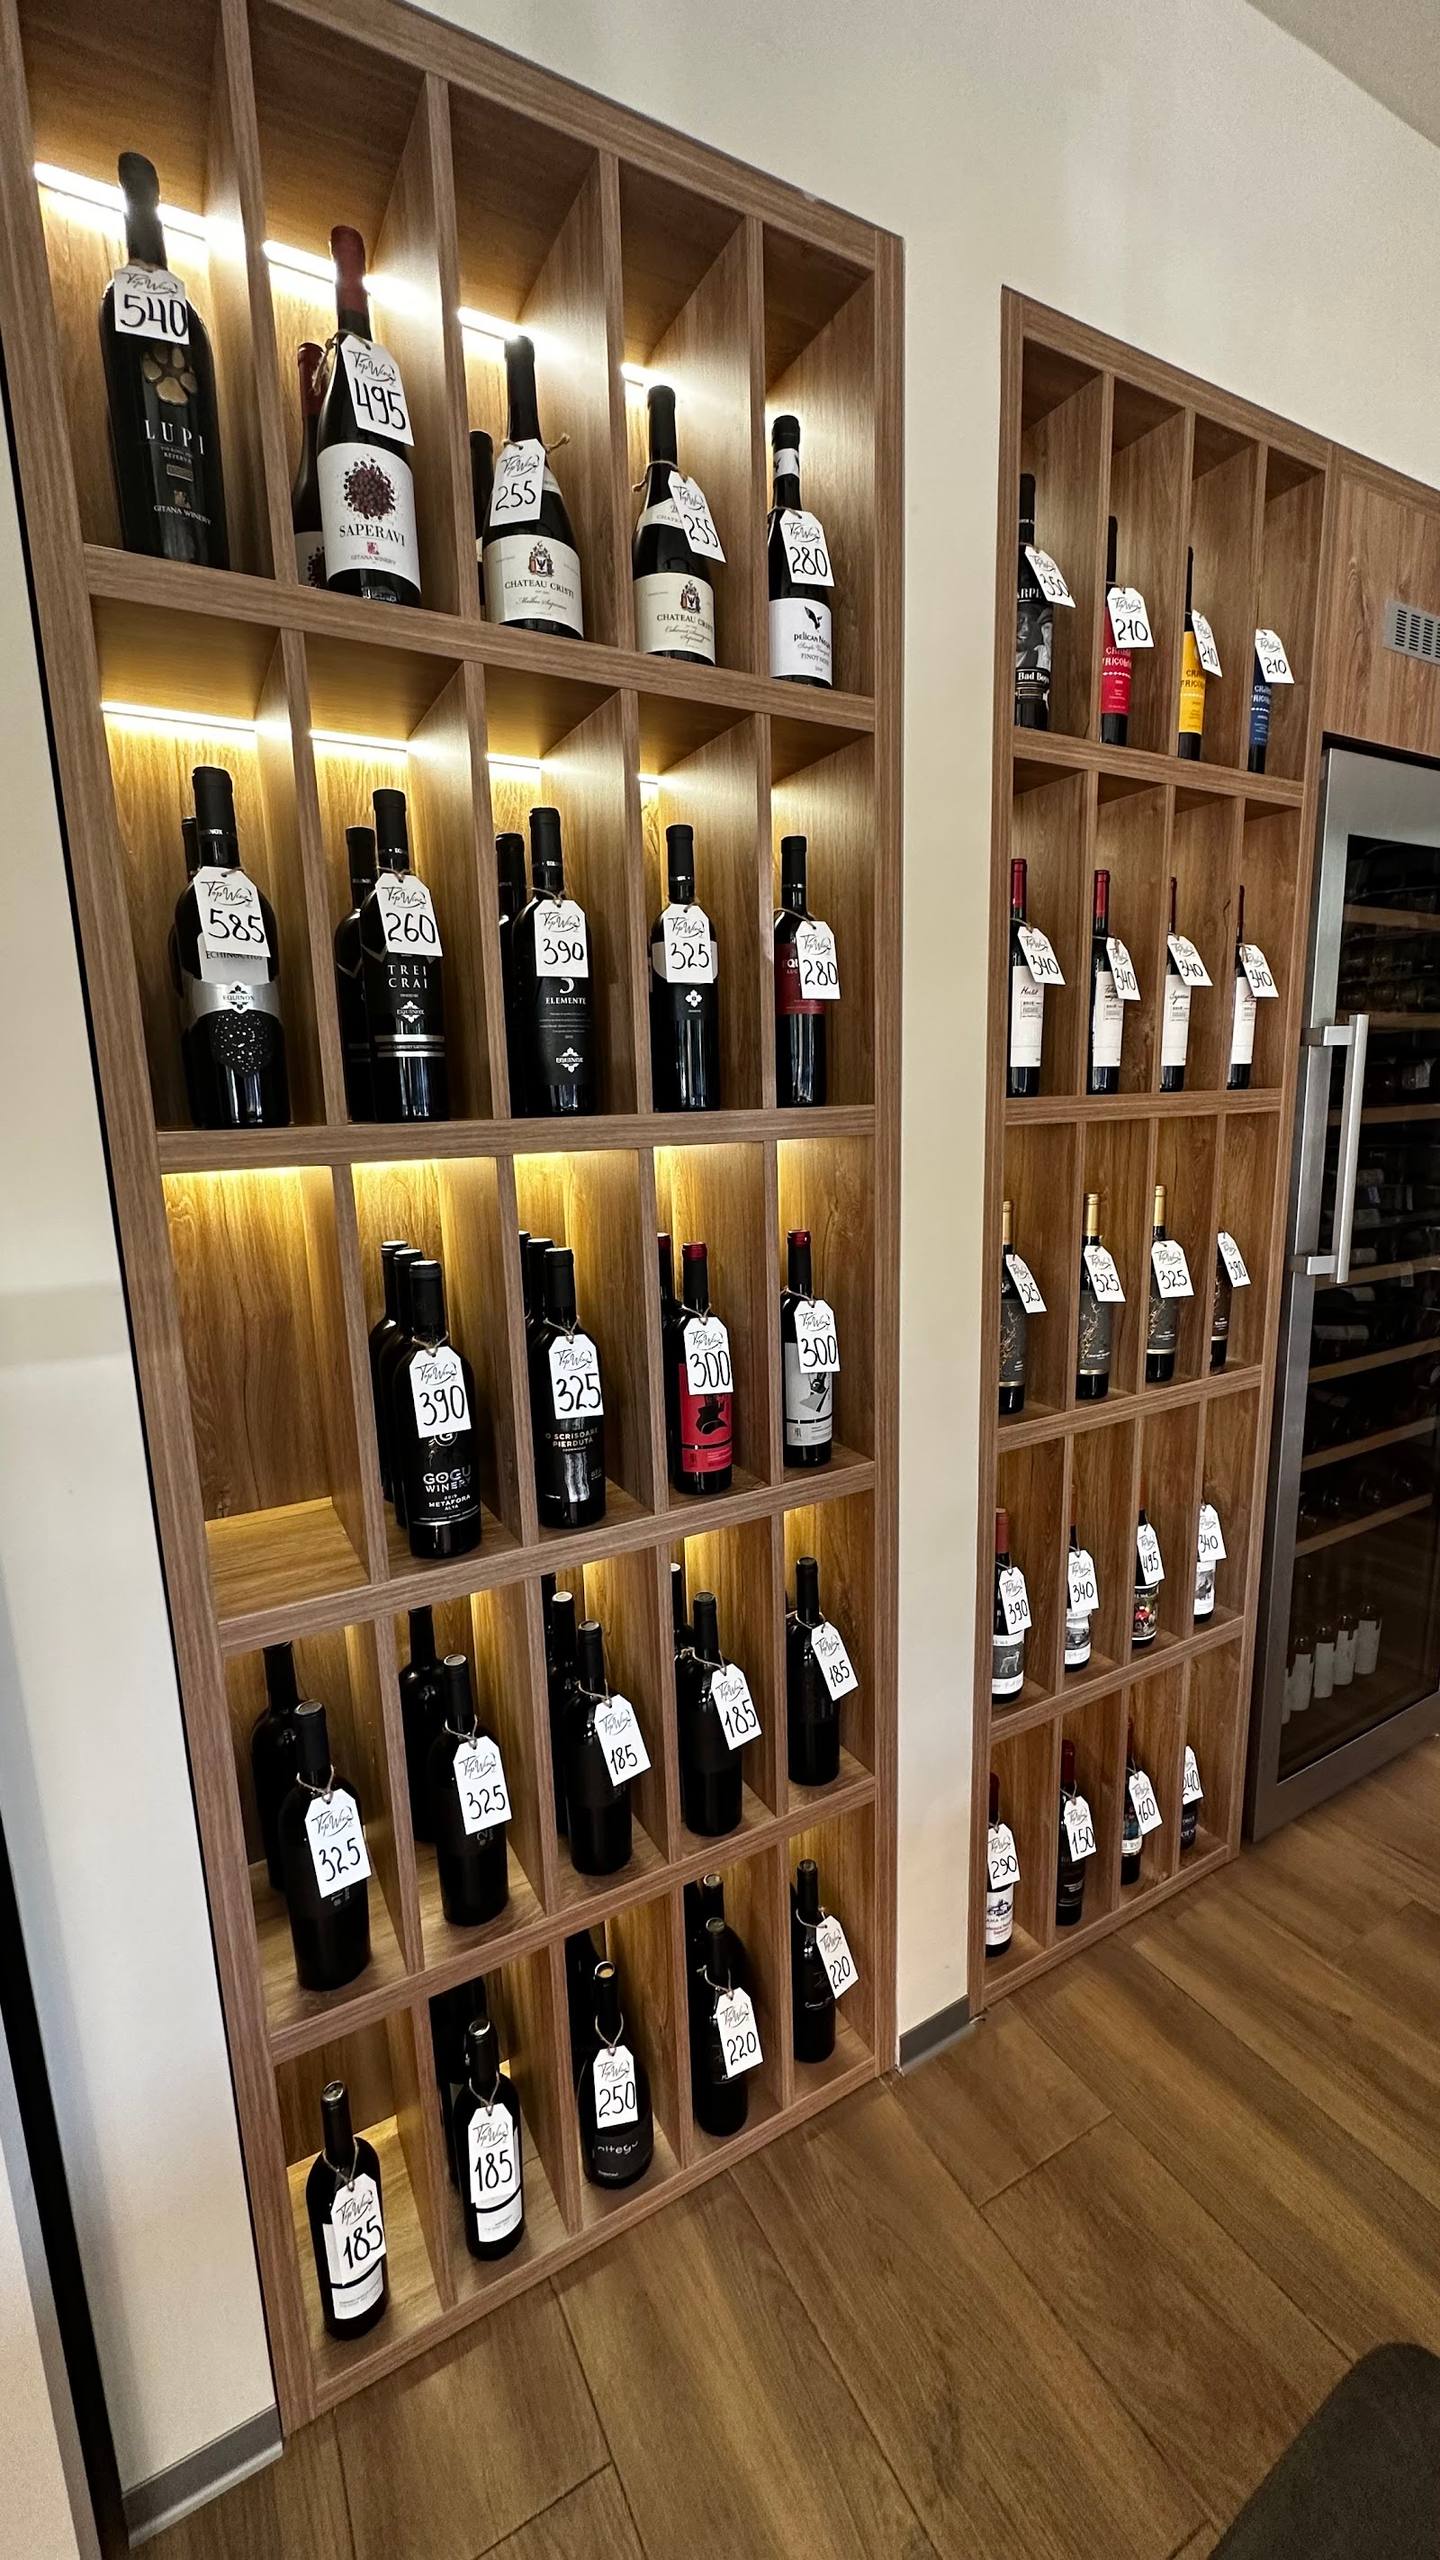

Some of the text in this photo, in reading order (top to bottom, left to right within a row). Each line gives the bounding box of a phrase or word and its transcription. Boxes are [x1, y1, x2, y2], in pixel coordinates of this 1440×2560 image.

[120, 295, 188, 337] 540
[354, 377, 407, 431] 495
[144, 419, 205, 456] LUPI
[495, 480, 536, 512] 255
[339, 523, 406, 547] SAPERAVI
[683, 514, 719, 548] 255
[789, 546, 829, 577] 280
[504, 579, 575, 600] CHATEAU CRISTI
[1042, 573, 1070, 598] 350
[656, 613, 696, 624] CHATEAU
[1115, 618, 1149, 641] 210
[1200, 641, 1219, 668] 210
[1264, 656, 1287, 675] 210
[1018, 672, 1035, 681] Bad
[207, 908, 265, 944] 585
[386, 913, 437, 944] 260
[543, 938, 584, 965] 390
[671, 942, 710, 970] 325
[1030, 954, 1060, 976] 340
[387, 964, 427, 977] TREI
[802, 959, 838, 986] 280
[1114, 968, 1137, 992] 340
[1179, 959, 1204, 977] 340
[1249, 969, 1273, 989] 340
[388, 977, 428, 989] CRAI
[545, 997, 587, 1005] ELEMENTE
[1093, 1273, 1120, 1293] 325
[1159, 1269, 1188, 1290] 325
[801, 1335, 838, 1368] 300
[690, 1350, 730, 1388] 300
[556, 1372, 601, 1412] 325
[418, 1385, 466, 1427] 390
[554, 1427, 598, 1440] SCRISOARE
[423, 1464, 471, 1485] GOGU
[425, 1476, 471, 1493] WINERY
[429, 1494, 471, 1508] METAFORA
[1073, 1581, 1094, 1603] 340
[1008, 1599, 1028, 1625] 390
[828, 1659, 850, 1688] 185
[725, 1698, 757, 1739] 185
[610, 1743, 638, 1775] 185
[467, 1784, 506, 1820] 325
[1138, 1797, 1156, 1824] 160
[1071, 1826, 1095, 1855] 150
[319, 1837, 361, 1882] 325
[991, 1855, 1018, 1880] 290
[829, 1955, 851, 1990] 220
[726, 2031, 758, 2066] 220
[599, 2081, 636, 2119] 250
[474, 2149, 513, 2192] 185
[343, 2214, 383, 2270] 185
